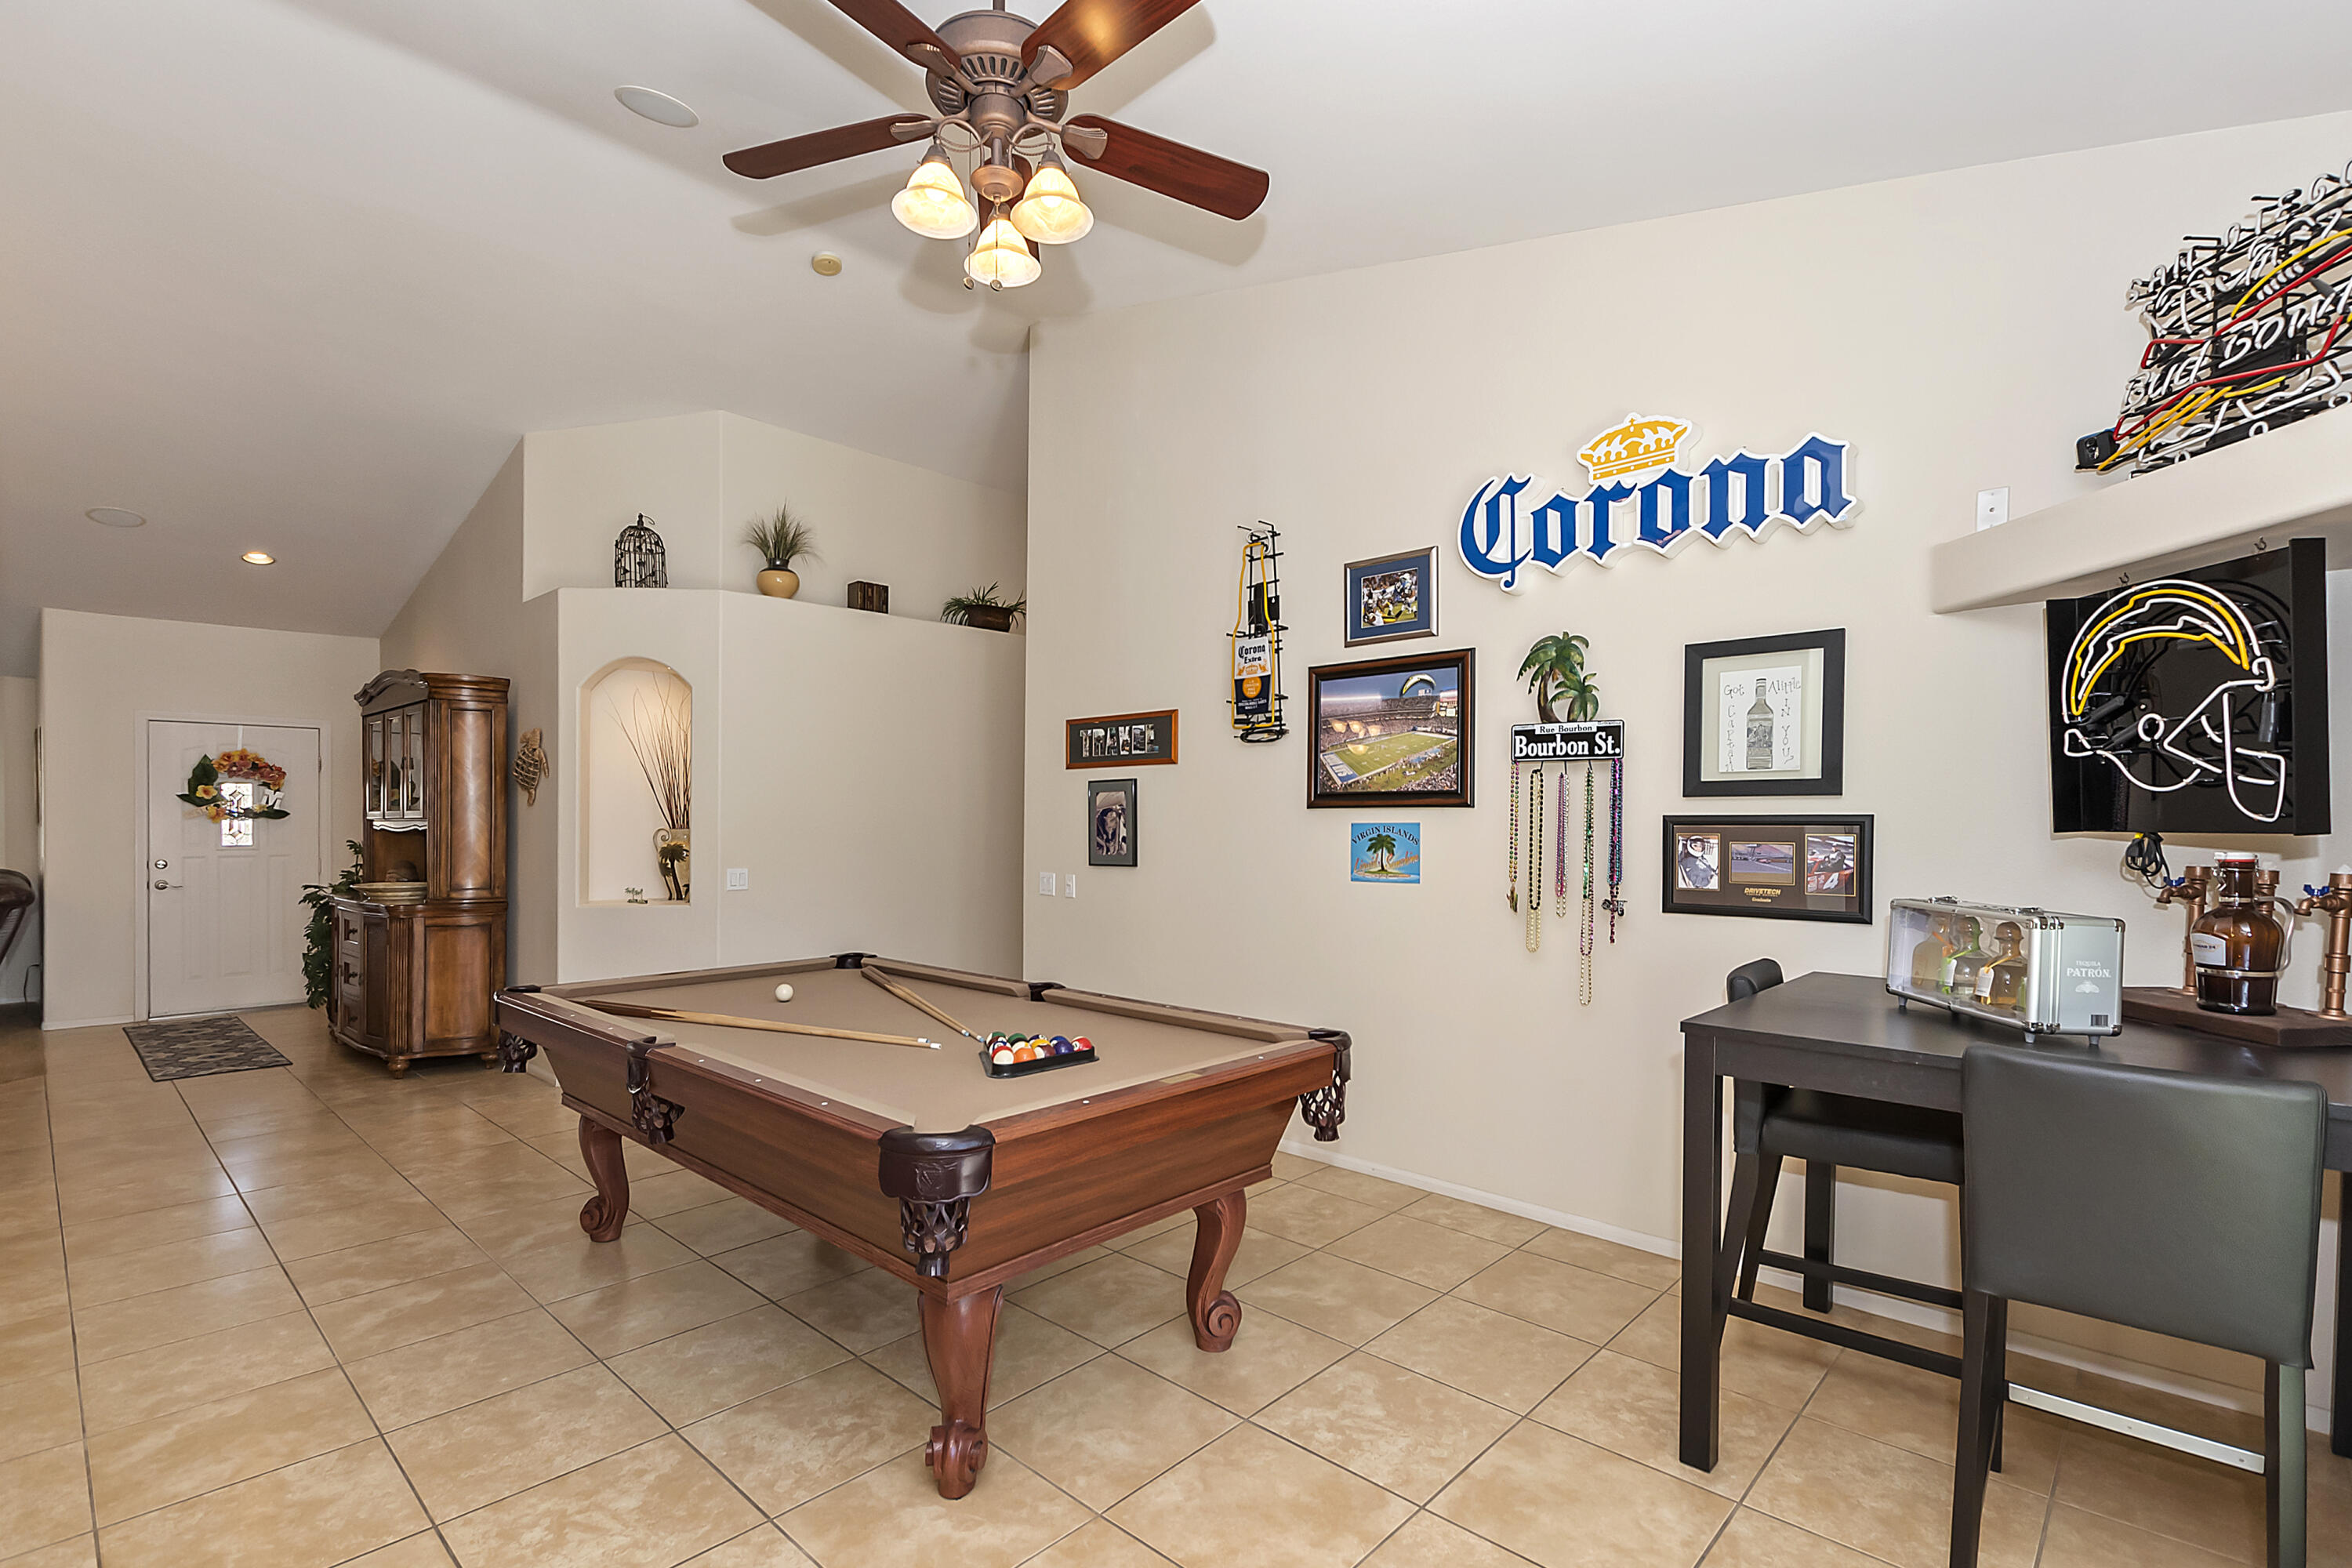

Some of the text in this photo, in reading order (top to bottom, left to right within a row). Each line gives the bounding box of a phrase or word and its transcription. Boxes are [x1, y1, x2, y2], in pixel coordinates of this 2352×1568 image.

[1458, 434, 1858, 591] Corona
[1238, 644, 1266, 659] Corona
[1244, 655, 1262, 664] Extra
[1723, 684, 1745, 699] Got
[1558, 724, 1593, 733] Bourbon
[1080, 724, 1160, 757] TRAVEL
[1514, 731, 1621, 757] Bourbon St.
[1352, 825, 1419, 845] VIRGIN ISLANDS
